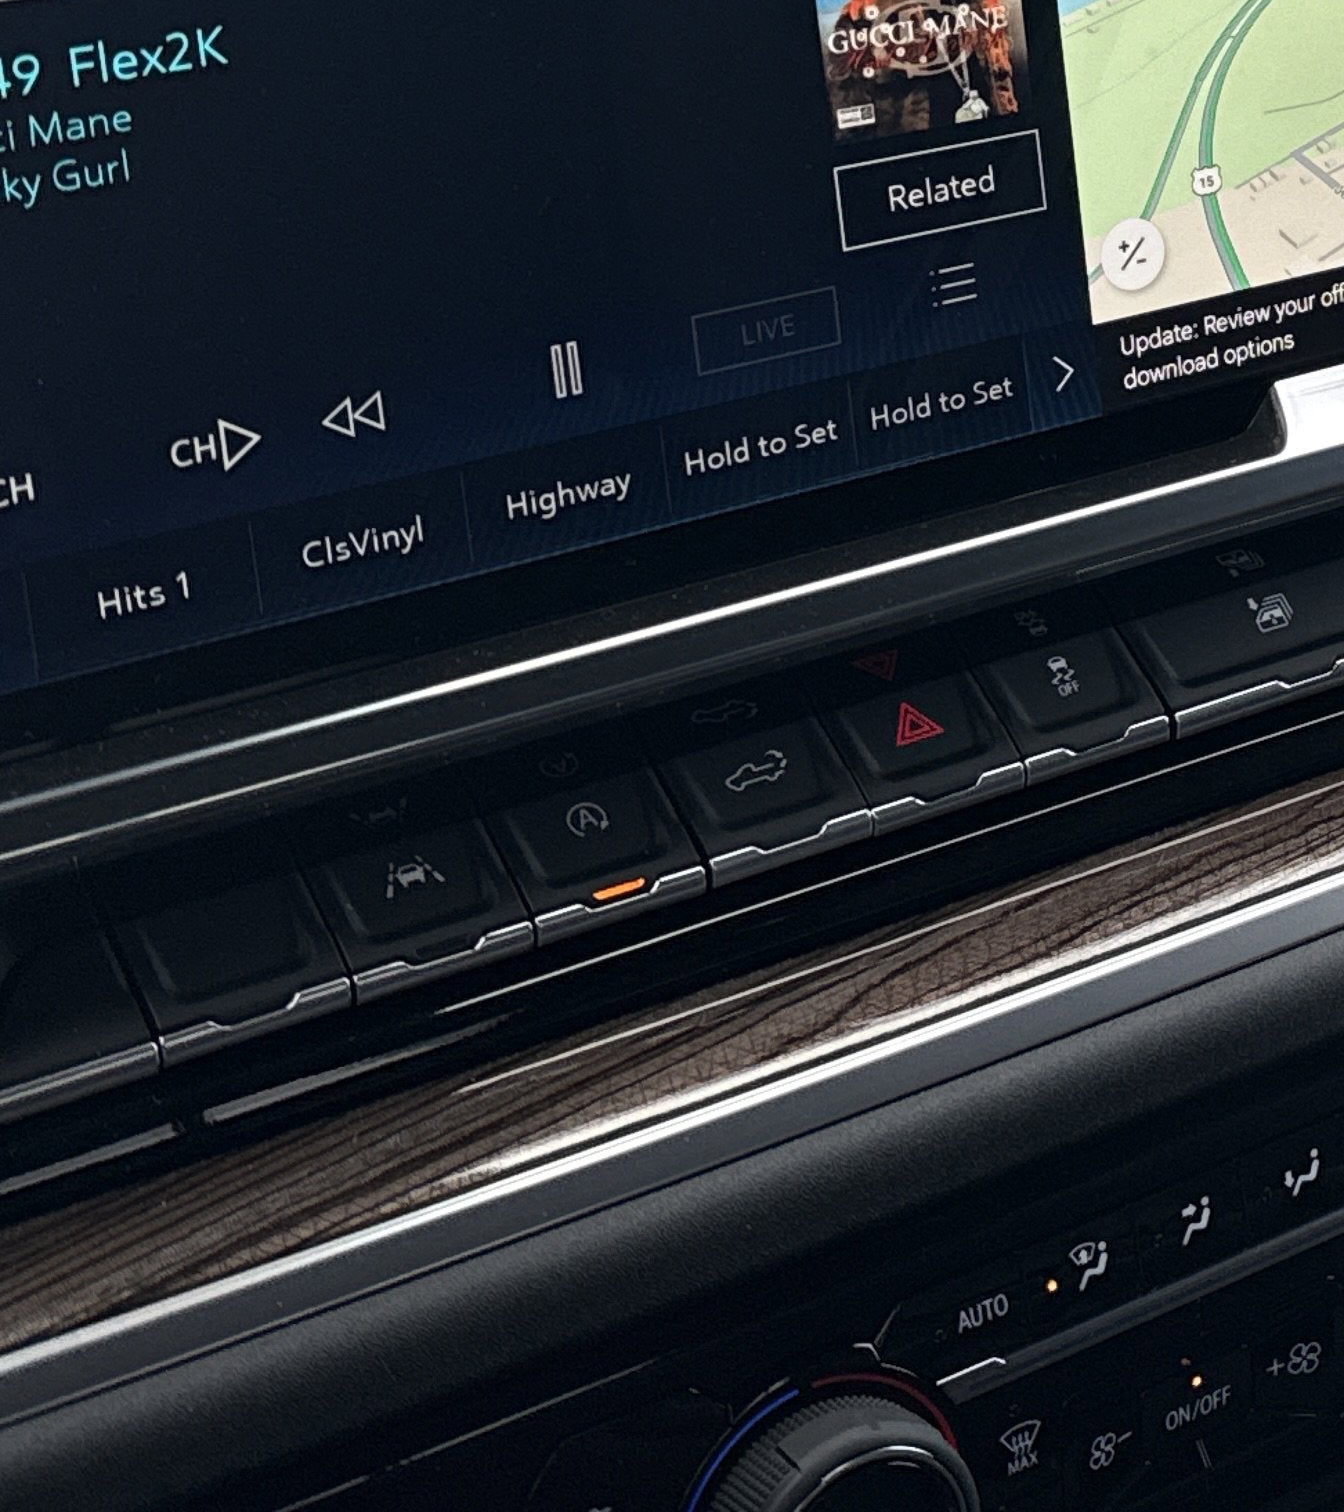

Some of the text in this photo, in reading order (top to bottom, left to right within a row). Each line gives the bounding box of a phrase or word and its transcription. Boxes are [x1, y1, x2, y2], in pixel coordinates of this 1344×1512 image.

[827, 4, 1009, 55] GUCCI MANE
[68, 24, 229, 88] Flex2K
[0, 109, 133, 153] i Mane
[52, 146, 131, 192] Gurl
[888, 164, 995, 212] Related
[1200, 175, 1215, 188] 15
[741, 314, 796, 346] LIVE
[1119, 321, 1200, 359] Update:
[1203, 301, 1271, 337] Review
[1274, 291, 1316, 322] your
[1122, 331, 1296, 390] download options
[870, 376, 1014, 431] Hold to Set
[170, 433, 217, 469] CH
[683, 419, 839, 477] Hold to Set
[505, 472, 632, 521] Highway
[301, 513, 425, 569] ClsVinyl
[97, 570, 191, 620] Hits 1
[958, 1293, 1009, 1334] AUTO
[1165, 1384, 1232, 1431] ON/OFF
[1007, 1450, 1039, 1477] MAX
